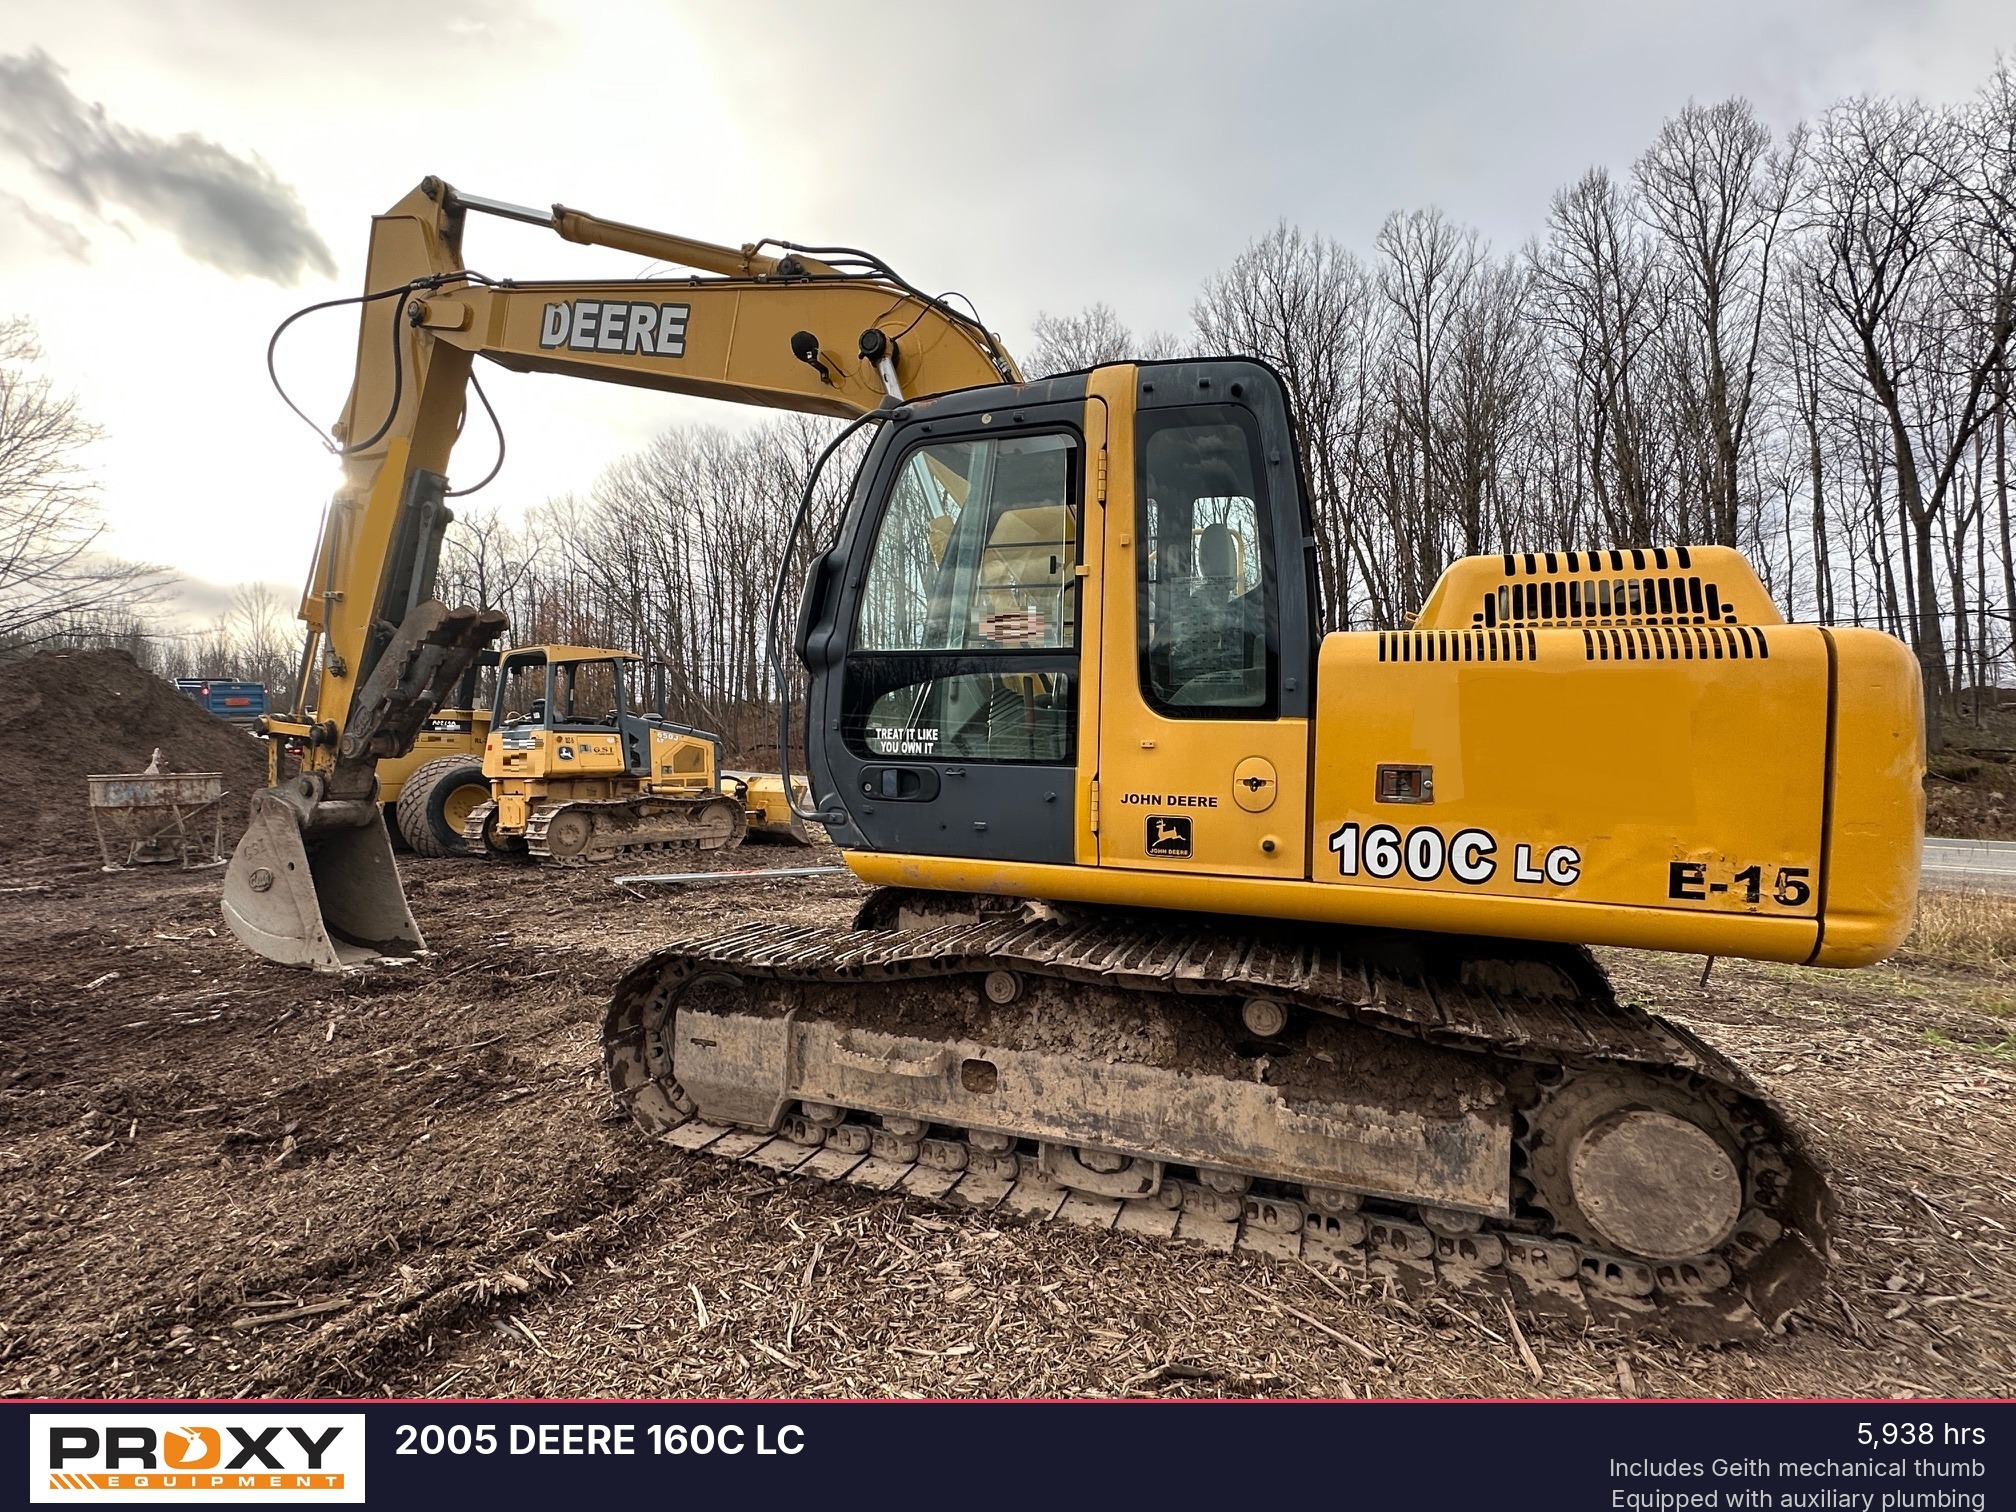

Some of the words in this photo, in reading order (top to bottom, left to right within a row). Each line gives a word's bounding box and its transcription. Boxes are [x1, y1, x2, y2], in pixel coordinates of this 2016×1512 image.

[540, 299, 690, 358] DEERE
[657, 731, 679, 741] 650J
[876, 728, 904, 740] TREAT
[906, 728, 916, 741] IT
[917, 728, 939, 741] LIKE
[880, 741, 899, 753] YOU
[901, 741, 922, 754] OWN
[924, 742, 934, 754] IT
[1120, 793, 1162, 806] JOHN
[1166, 795, 1218, 808] DEERE
[1150, 847, 1168, 855] JOHN
[1168, 848, 1189, 856] DEERE
[1329, 822, 1497, 885] 160C
[1513, 844, 1581, 886] LC
[1668, 861, 1811, 907] E-15
